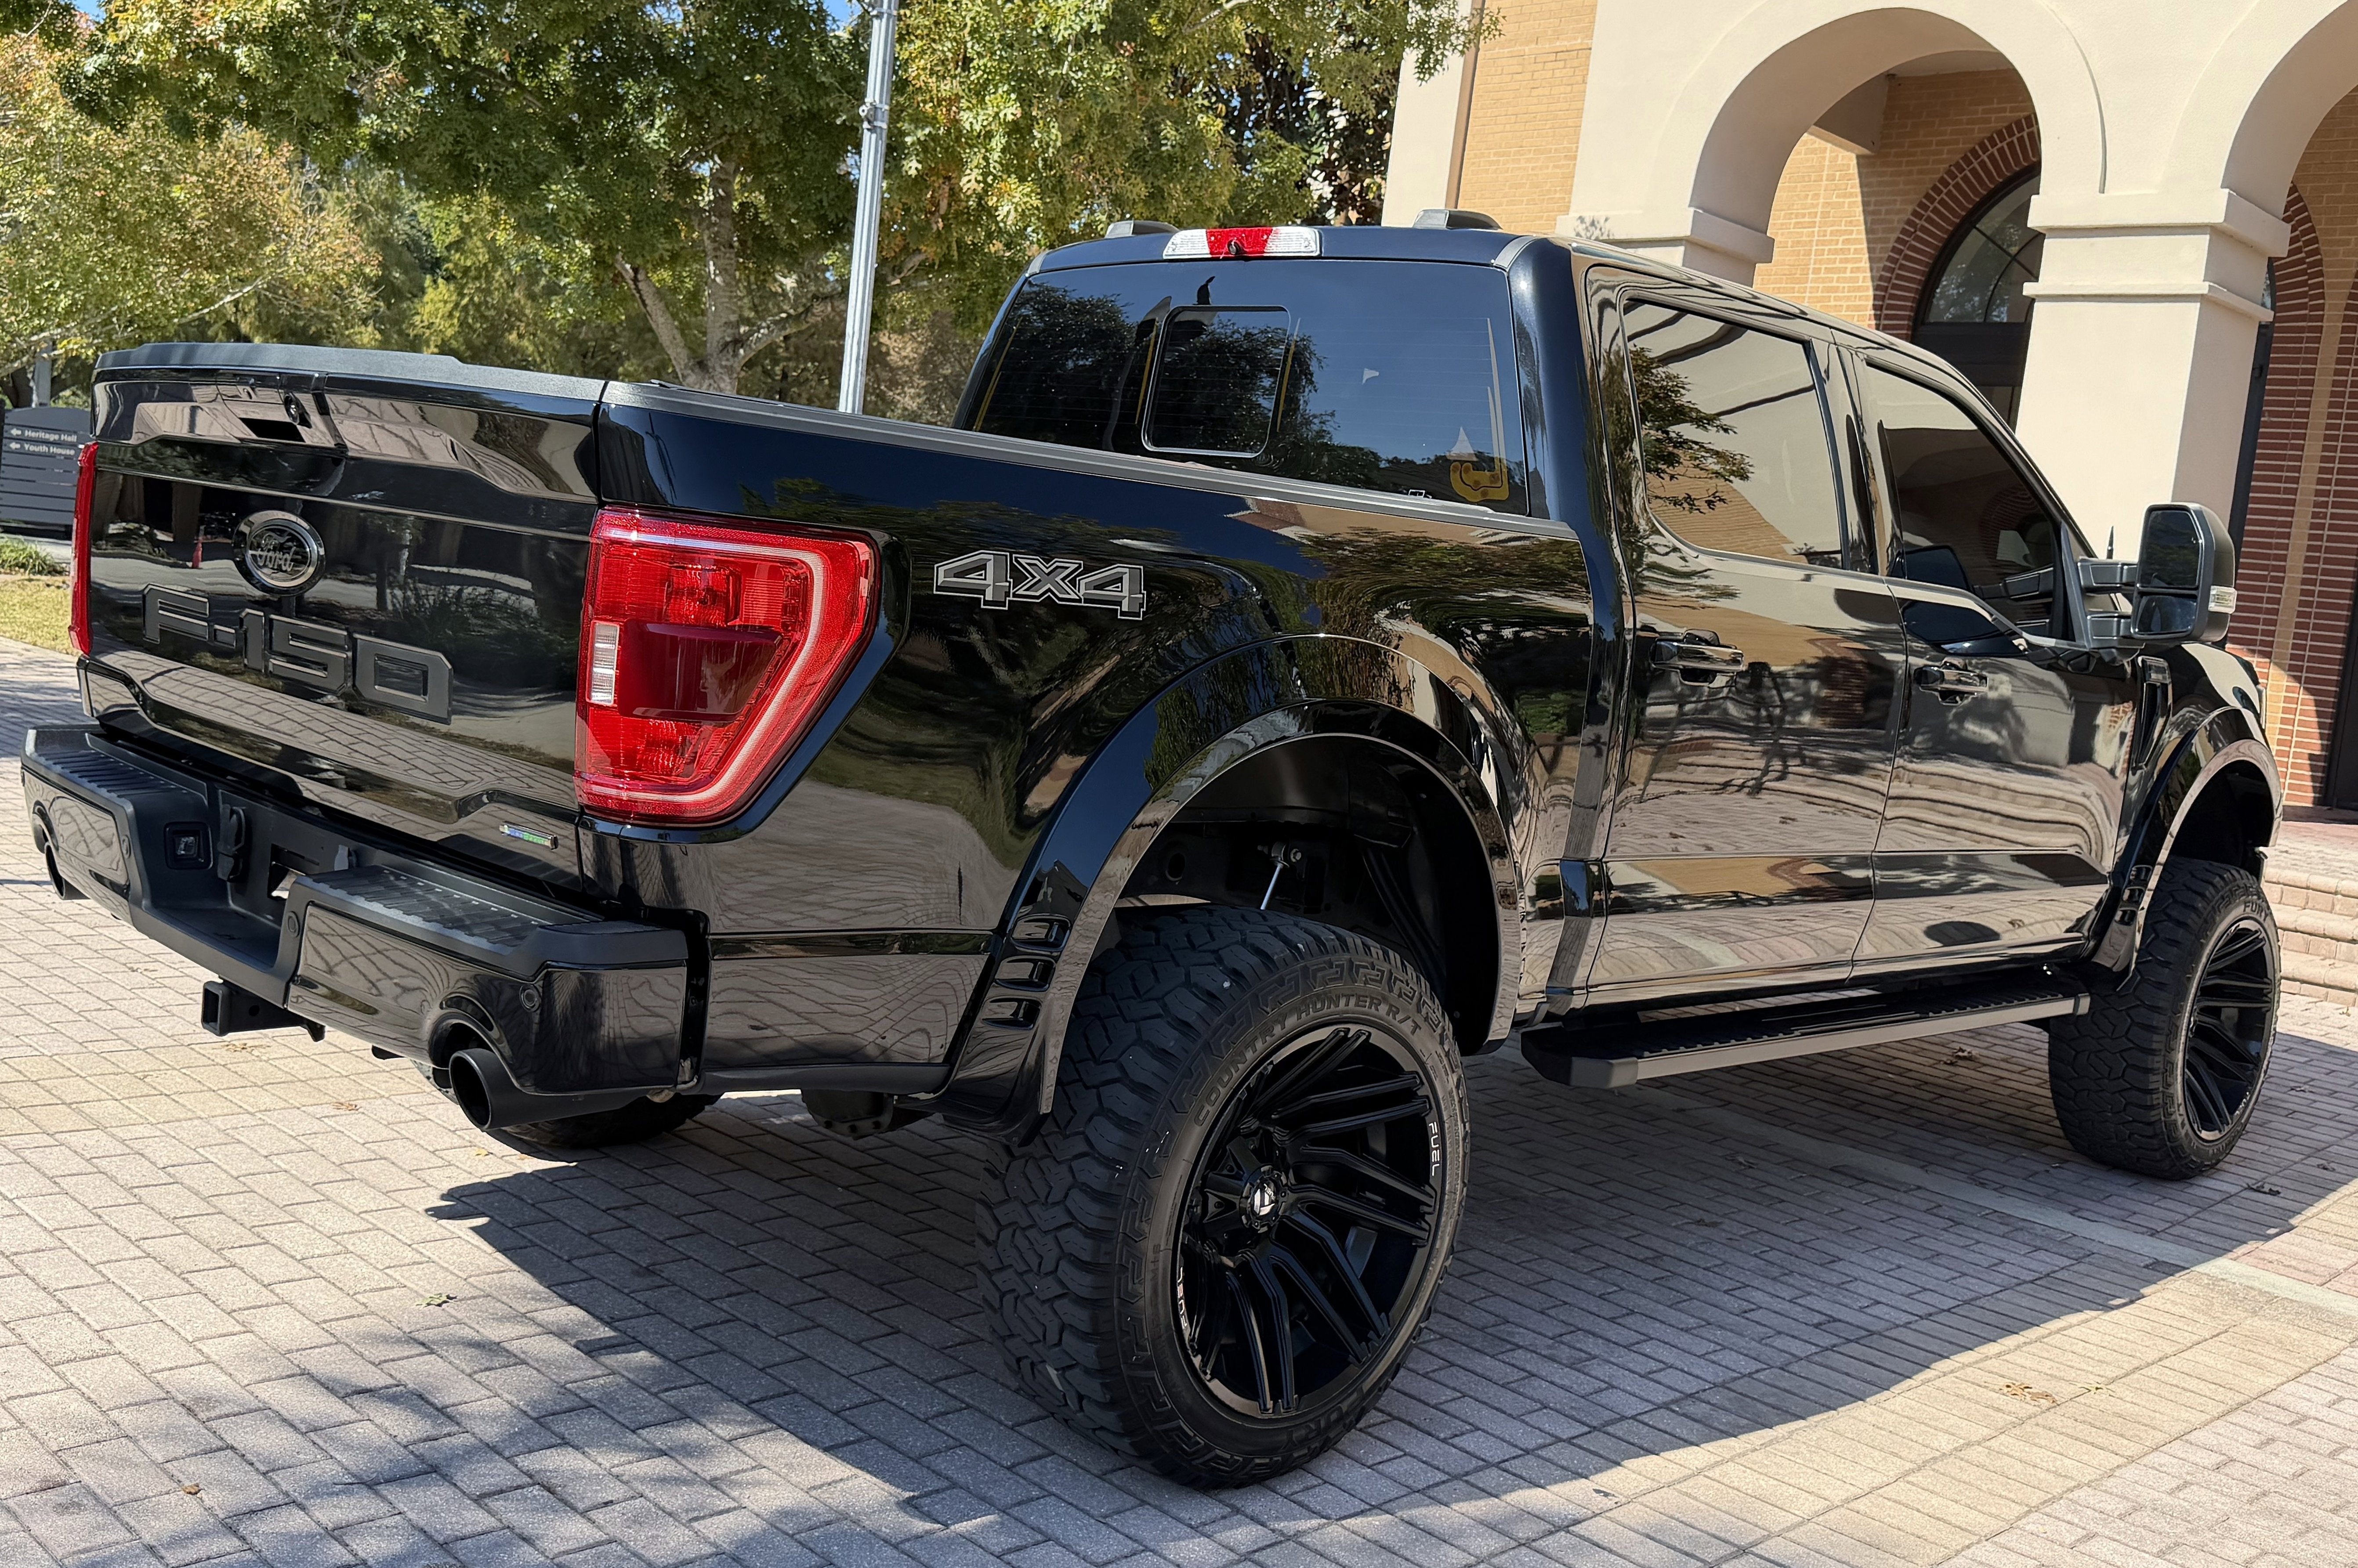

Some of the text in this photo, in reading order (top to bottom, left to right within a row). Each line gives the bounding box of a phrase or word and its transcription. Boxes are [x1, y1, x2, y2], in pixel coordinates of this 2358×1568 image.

[24, 429, 77, 442] Heritage Hall
[24, 443, 75, 455] Youth House
[249, 531, 297, 571] Ford
[142, 583, 453, 725] F-150
[1194, 993, 1422, 1127] COUNTRY HUNTER R/T
[1429, 1121, 1441, 1176] FUEL
[1177, 1267, 1188, 1329] FUEL
